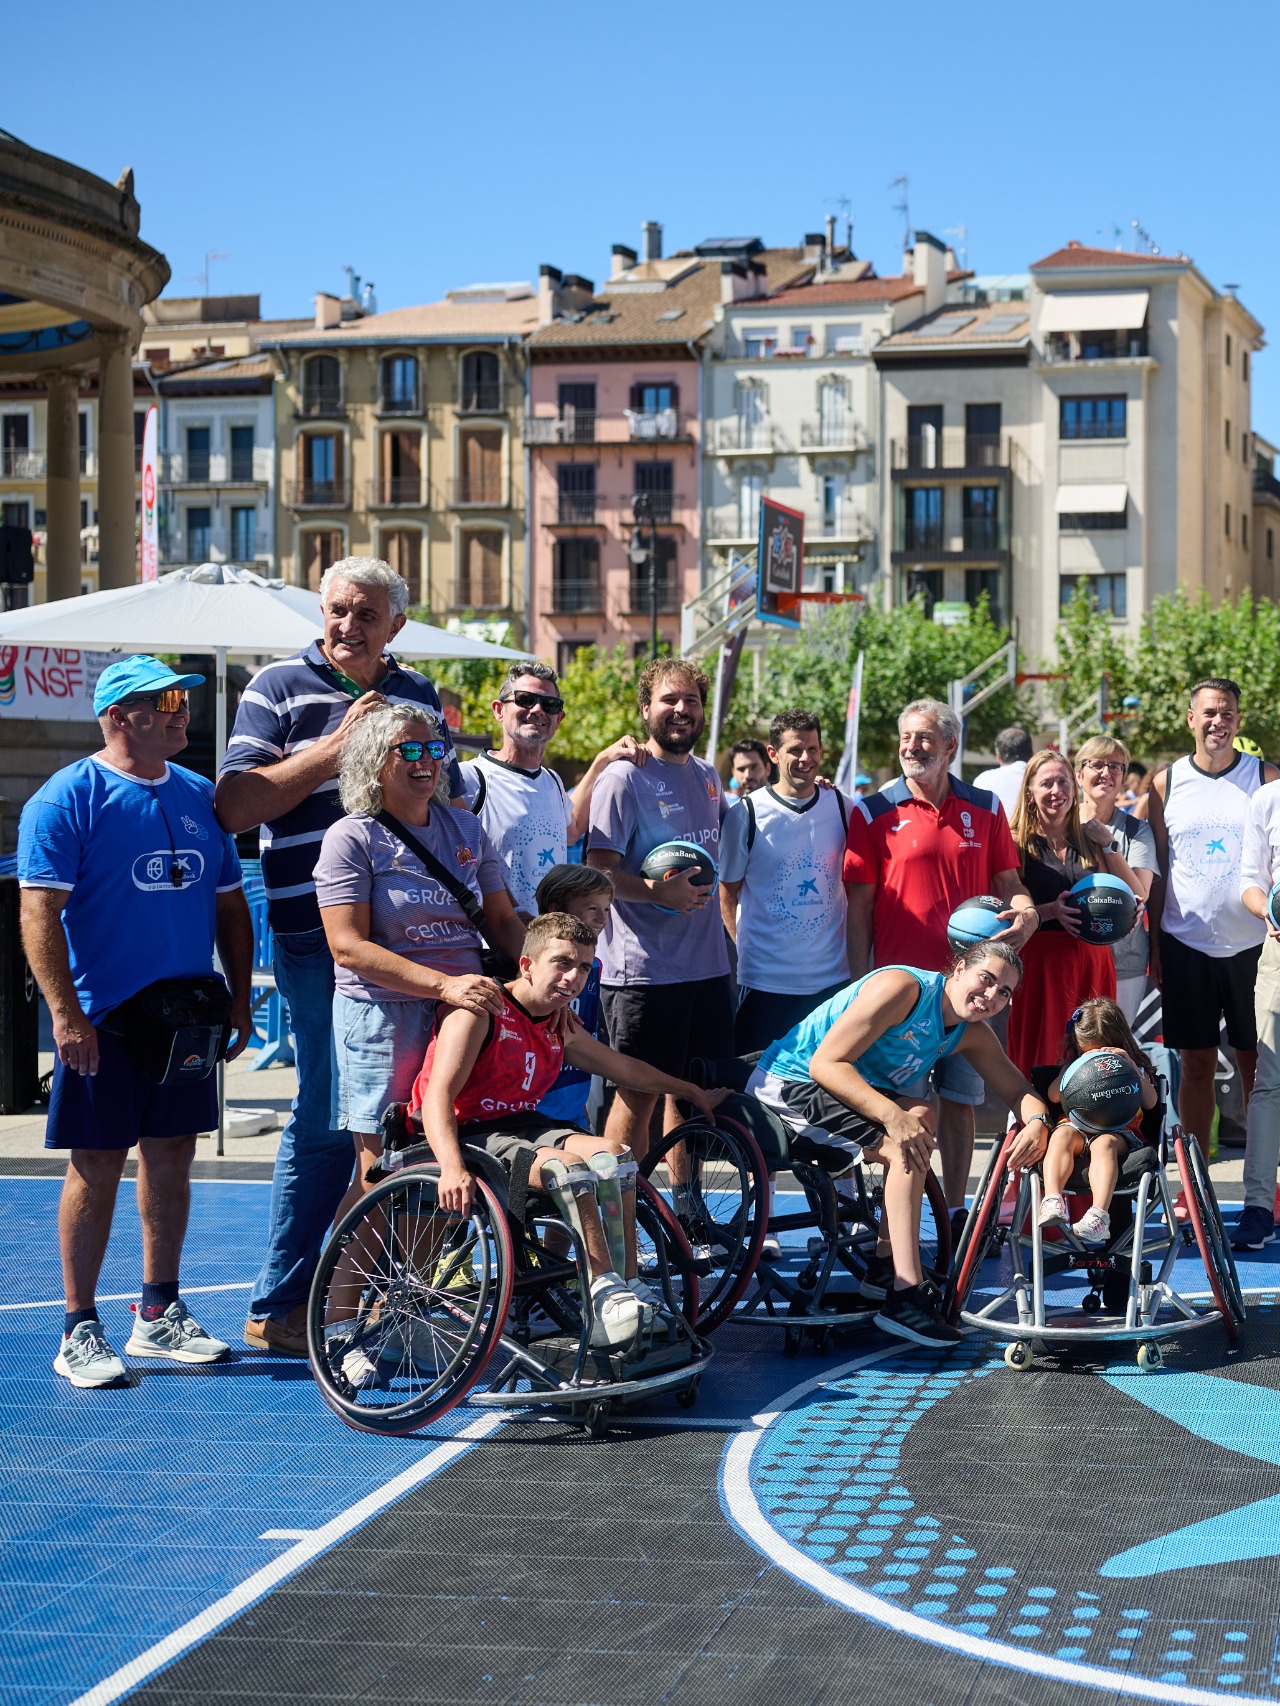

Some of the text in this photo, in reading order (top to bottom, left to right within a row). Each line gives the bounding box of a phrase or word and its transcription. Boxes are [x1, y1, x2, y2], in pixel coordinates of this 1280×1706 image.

[24, 666, 83, 698] NSF
[657, 850, 697, 860] CaixaBank
[1087, 895, 1123, 905] CaixaBank
[521, 1051, 536, 1091] 9
[887, 1053, 924, 1085] 18
[1091, 1085, 1131, 1101] CaixaBank
